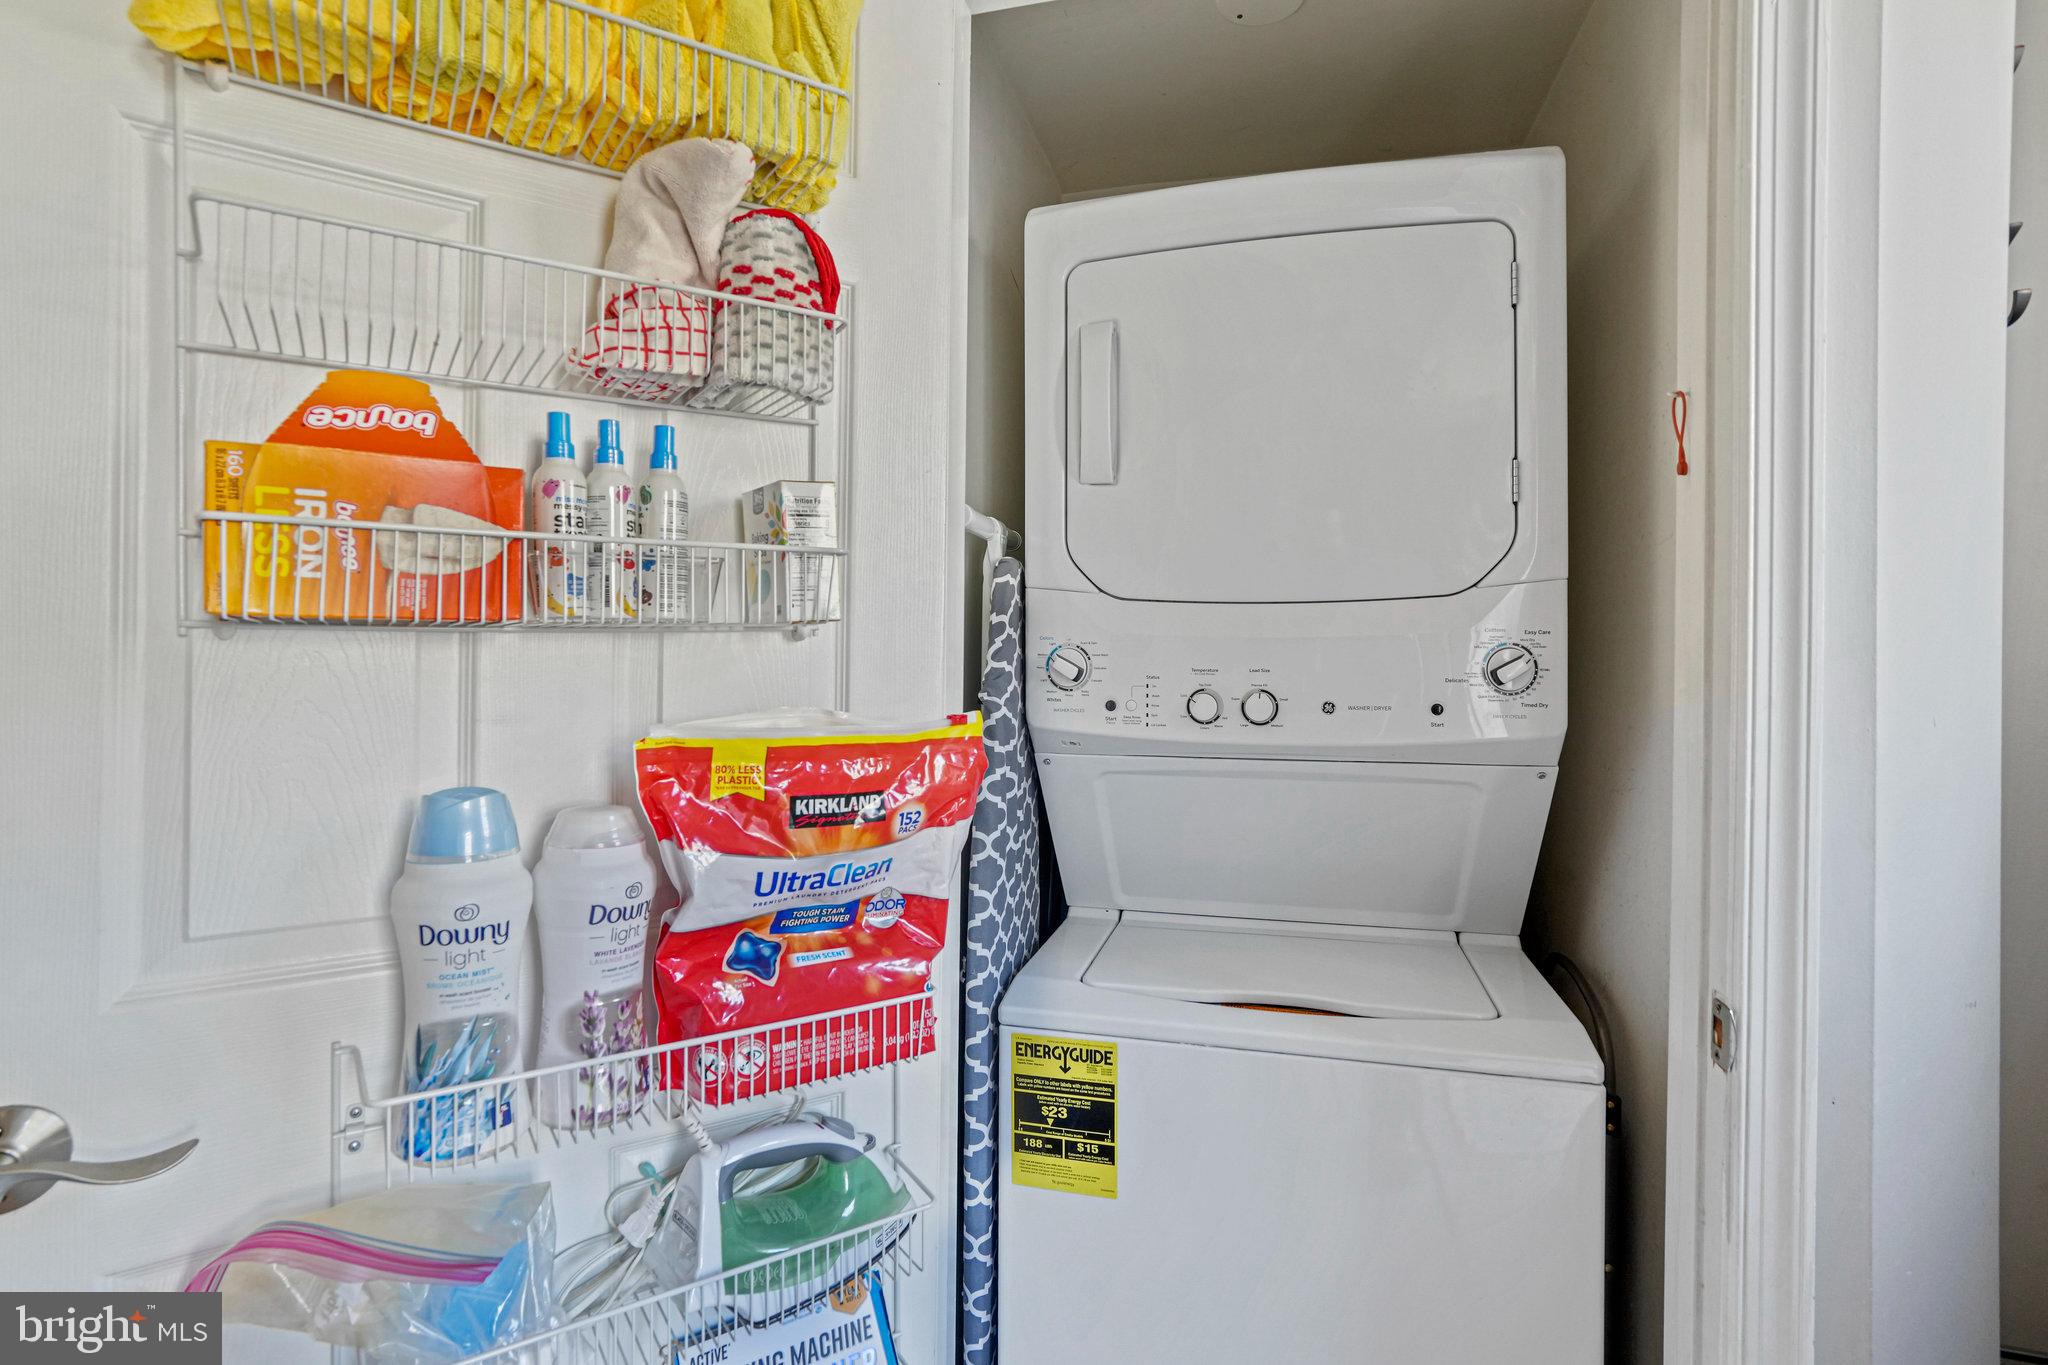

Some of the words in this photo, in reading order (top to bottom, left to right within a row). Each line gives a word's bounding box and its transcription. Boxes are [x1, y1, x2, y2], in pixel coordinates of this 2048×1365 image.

[304, 404, 439, 437] bounce
[228, 449, 244, 477] 160
[294, 488, 328, 579] IRON
[715, 765, 736, 774] 80%
[738, 765, 762, 774] LESS
[796, 794, 881, 815] KIRKLAND
[898, 810, 922, 826] 152
[898, 824, 917, 834] PACS
[754, 857, 894, 897] UltraClean
[752, 897, 788, 908] PREMIUM
[791, 892, 827, 900] LAUNDRY
[830, 884, 868, 896] DETERGENT
[870, 877, 886, 886] PACS
[792, 908, 820, 918] TOUGH
[821, 906, 846, 916] STAIN
[866, 898, 906, 912] ODOR
[780, 918, 820, 927] FIGHTING
[820, 914, 850, 924] POWER
[418, 920, 510, 946] Downy
[611, 924, 640, 945] light
[445, 948, 486, 970] light
[594, 948, 617, 957] WHITE
[796, 952, 821, 963] FRESH
[822, 950, 846, 960] SCENT
[439, 972, 468, 980] OCEAN
[1015, 1042, 1114, 1066] ENERGYGUIDE
[1041, 1106, 1068, 1119] $23
[1023, 1137, 1043, 1148] 188
[1077, 1143, 1099, 1154] $15
[790, 1314, 873, 1365] MACHINE
